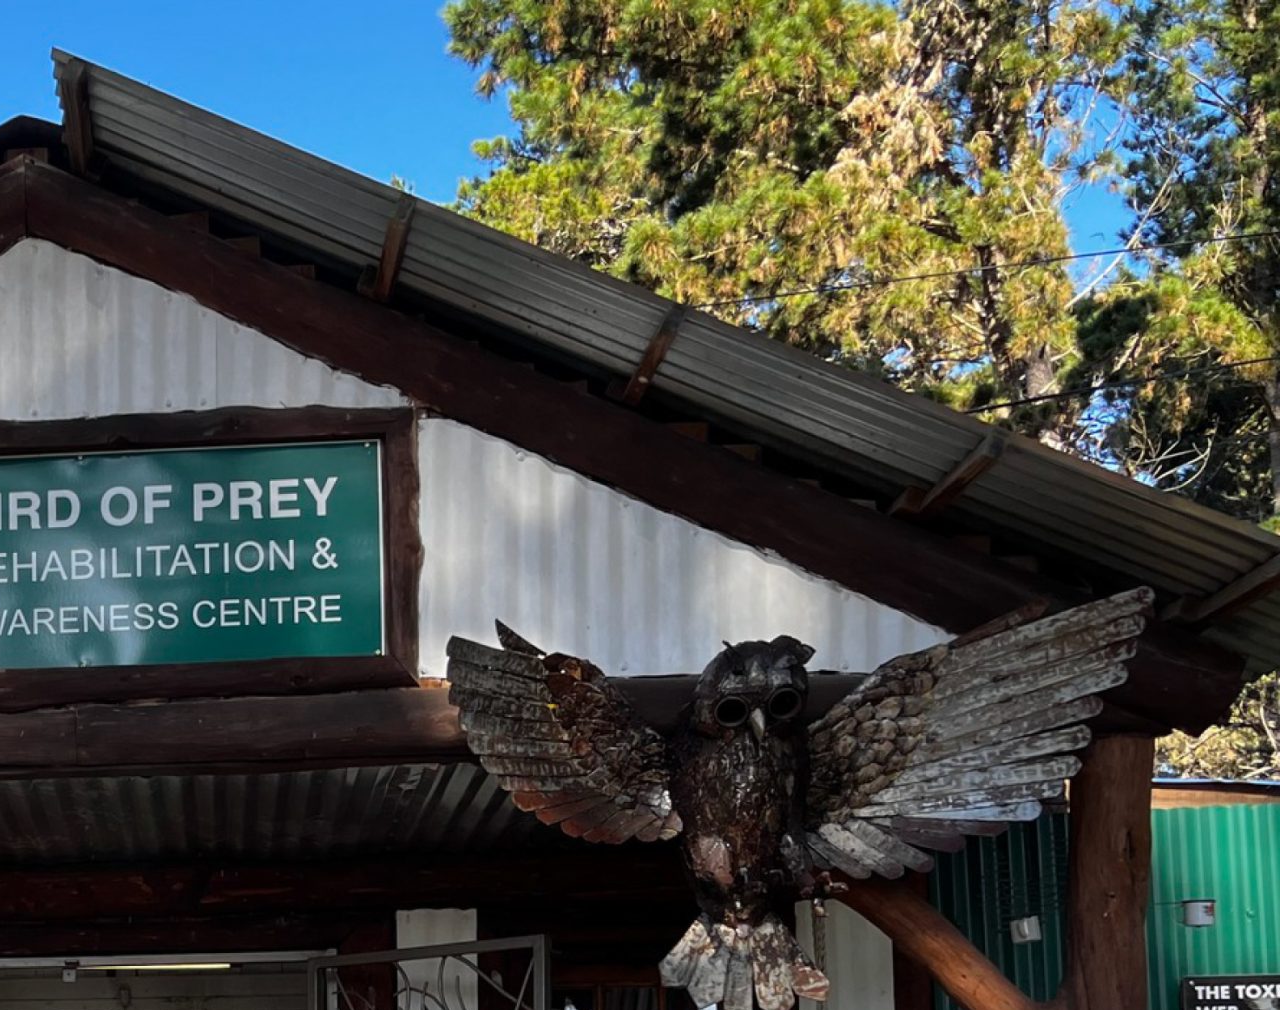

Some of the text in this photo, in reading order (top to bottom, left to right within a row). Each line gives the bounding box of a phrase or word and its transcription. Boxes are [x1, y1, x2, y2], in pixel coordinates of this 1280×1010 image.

[100, 483, 172, 526] OF
[193, 476, 338, 521] PREY
[312, 537, 338, 569] &
[192, 595, 342, 628] CENTRE
[1195, 985, 1231, 1000] THE
